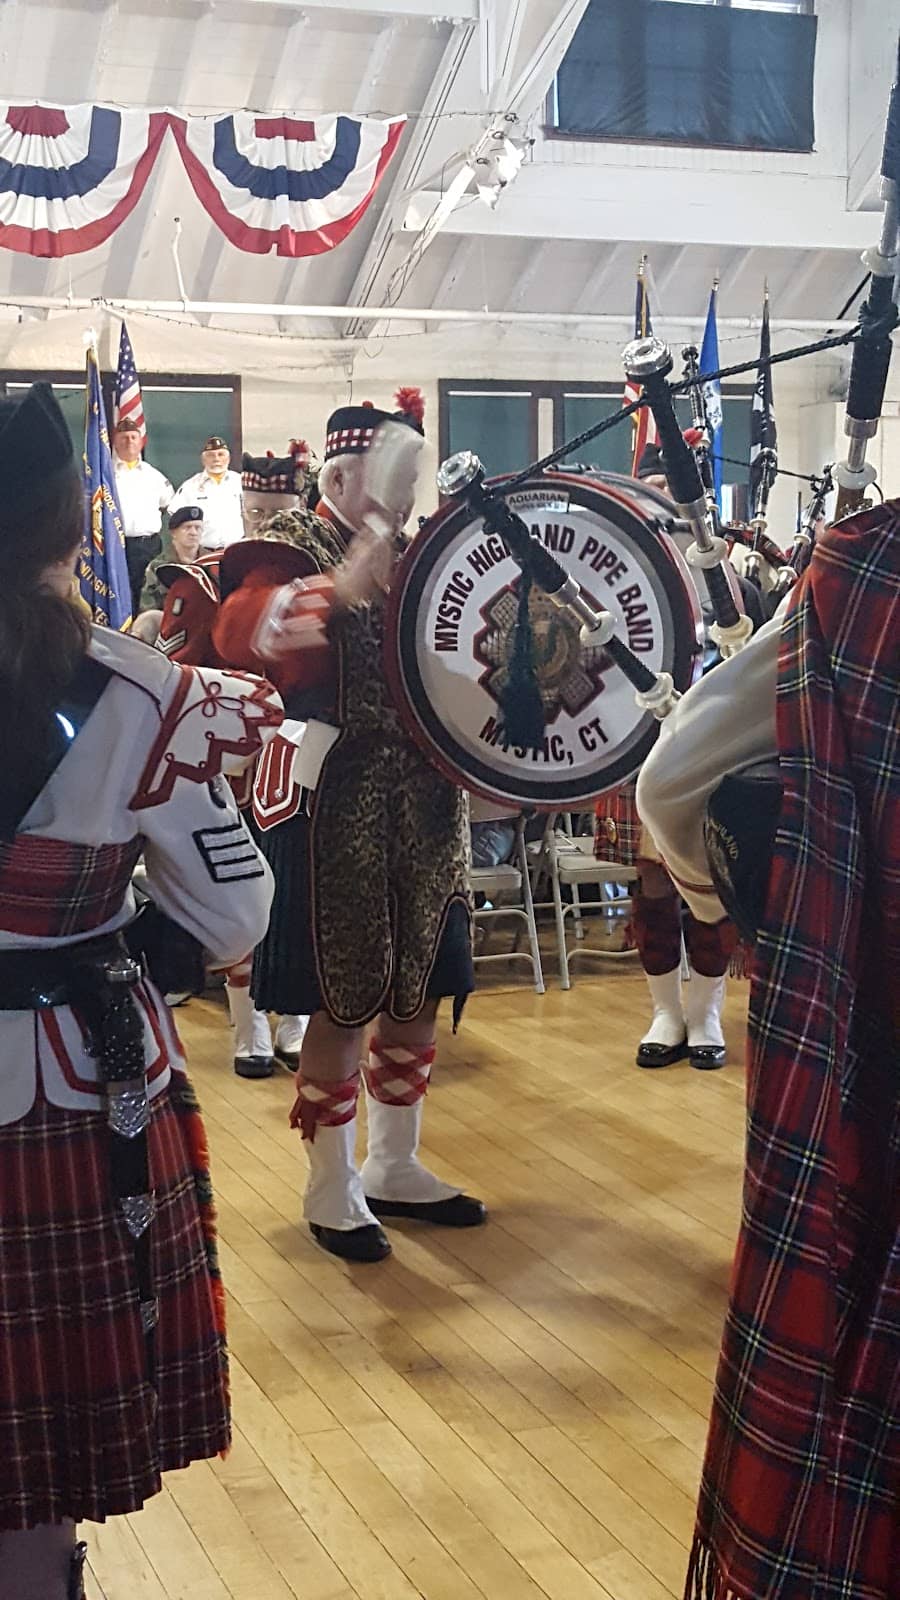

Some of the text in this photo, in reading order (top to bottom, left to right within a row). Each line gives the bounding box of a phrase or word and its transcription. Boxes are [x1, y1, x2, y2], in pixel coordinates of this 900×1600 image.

[508, 491, 565, 505] AQUARIAN
[434, 523, 654, 652] MYSTIC HIGAND PIPE BAND
[578, 717, 609, 752] CT
